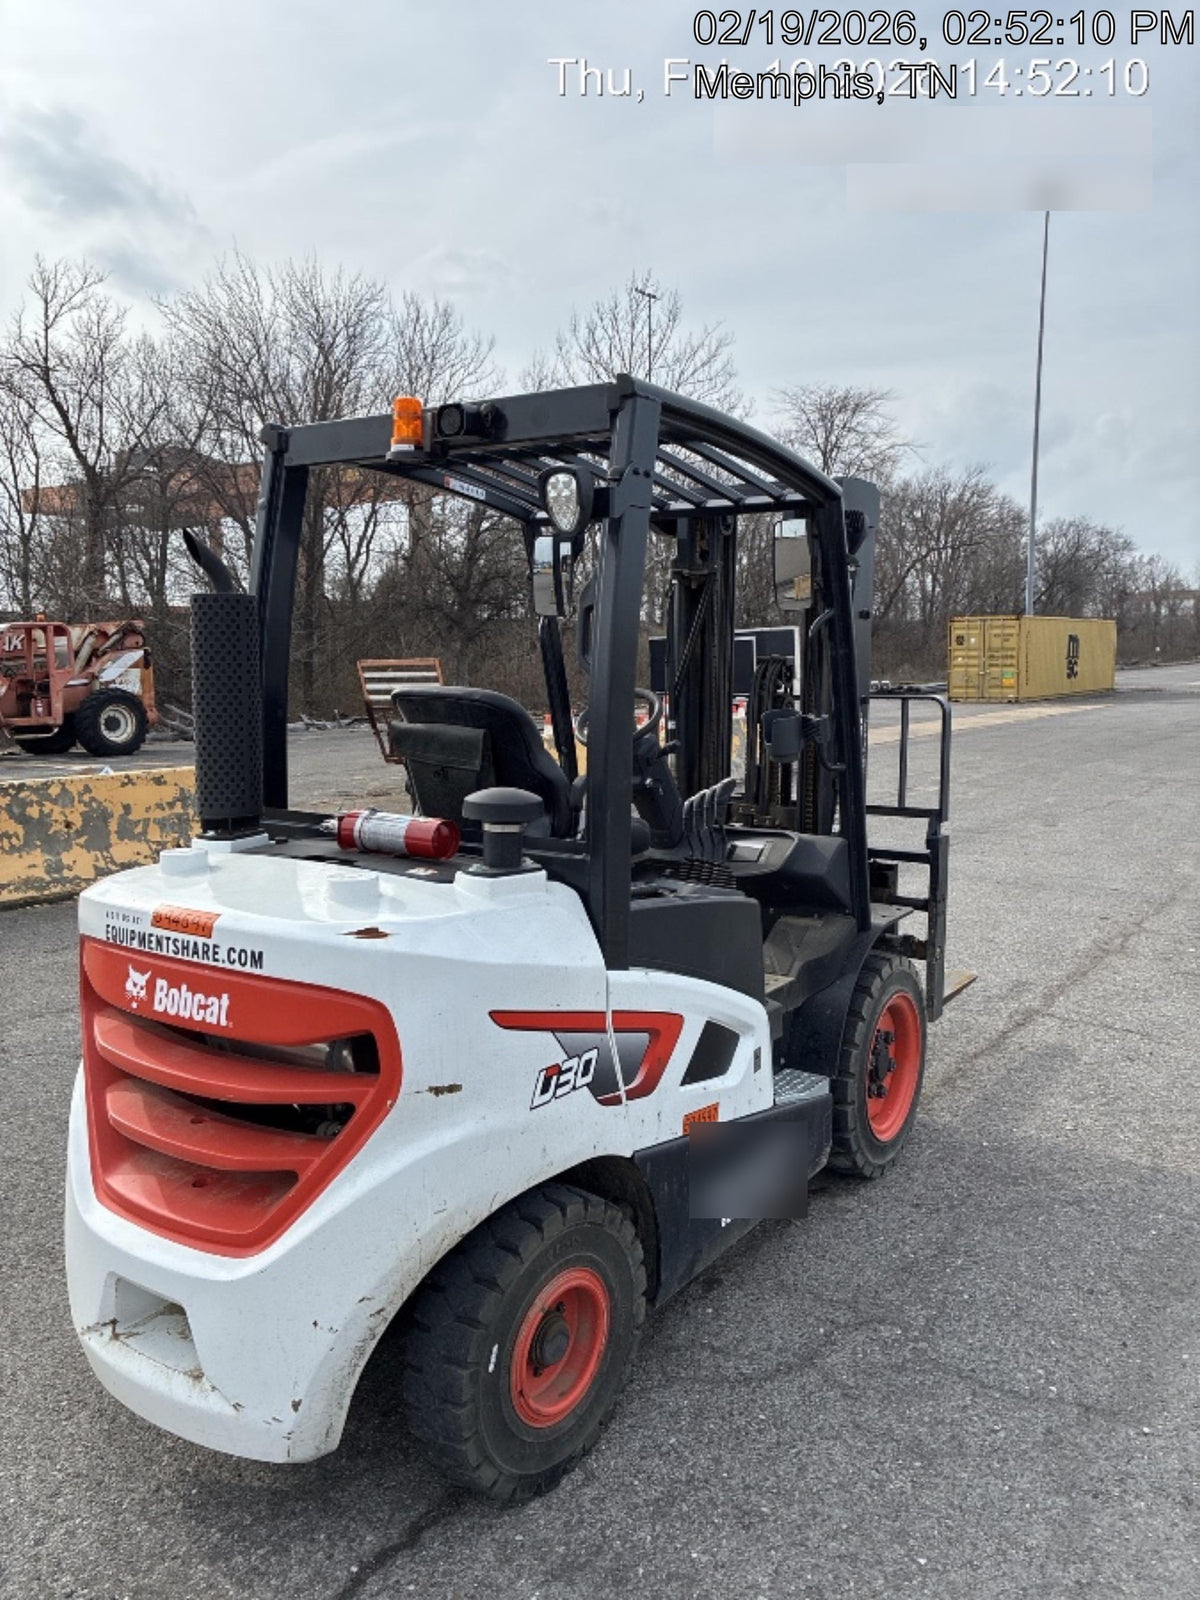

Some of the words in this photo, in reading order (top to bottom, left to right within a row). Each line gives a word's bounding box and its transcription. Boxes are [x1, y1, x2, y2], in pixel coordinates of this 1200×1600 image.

[105, 923, 264, 969] EQUIPMENTSHARE.COM
[153, 978, 230, 1026] Bobcat
[530, 1046, 600, 1111] D30
